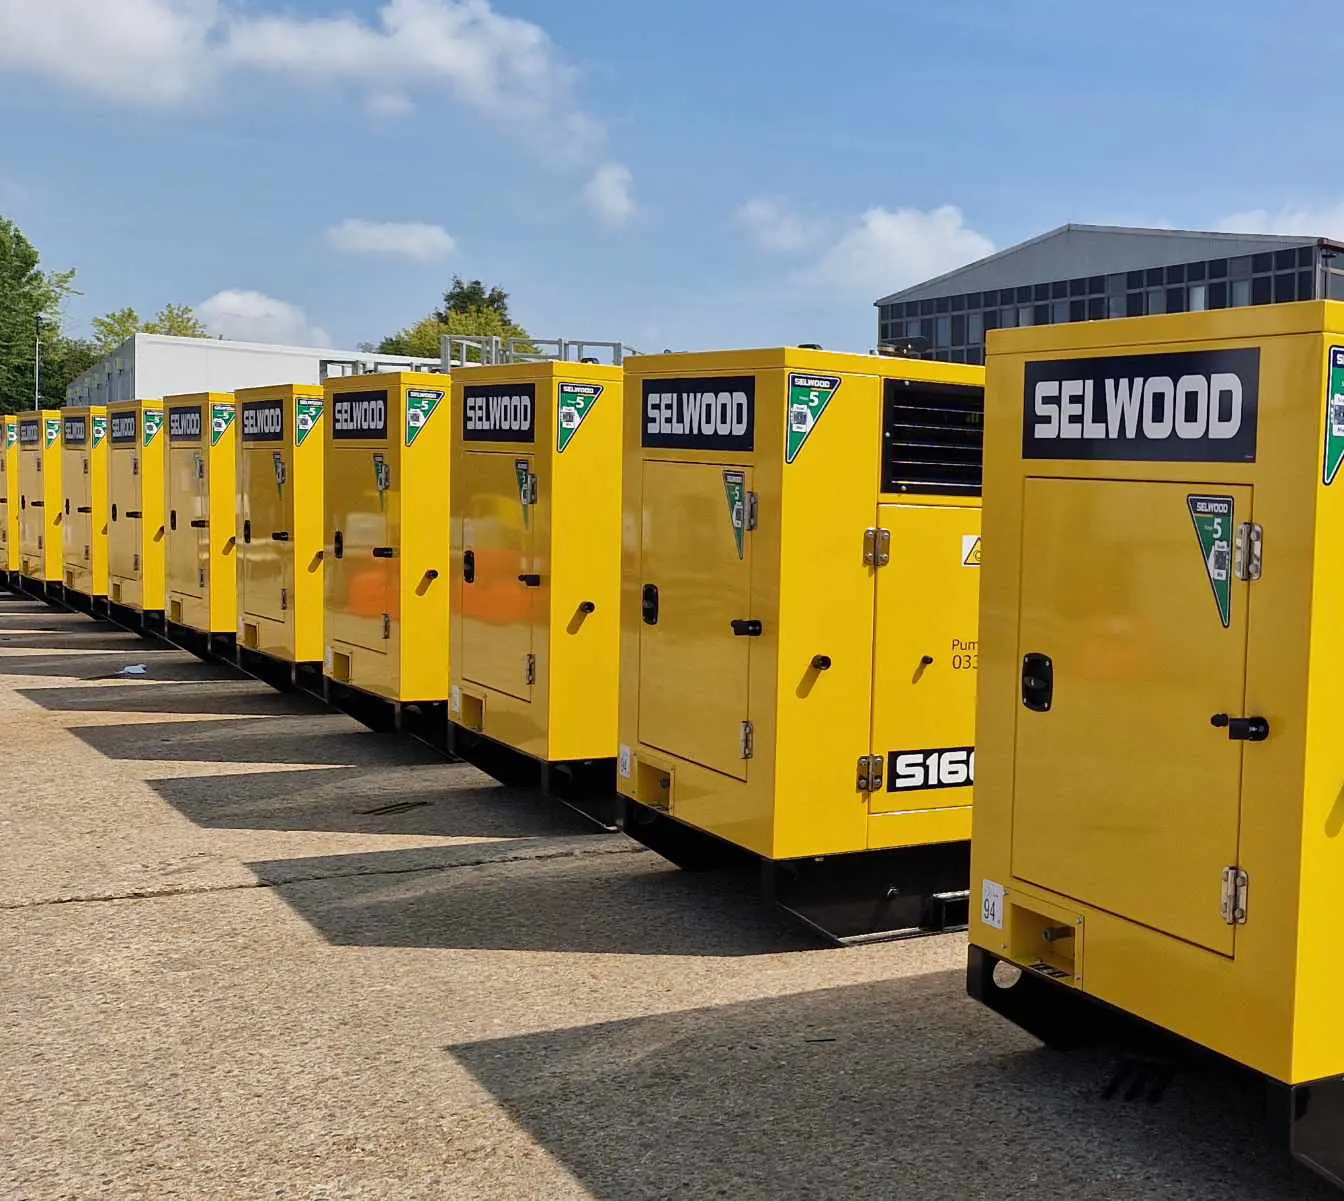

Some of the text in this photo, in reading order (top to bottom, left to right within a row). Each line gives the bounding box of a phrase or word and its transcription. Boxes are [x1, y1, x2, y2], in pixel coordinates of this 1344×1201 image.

[794, 377, 831, 388] SELWOOD
[421, 400, 429, 410] 5
[576, 396, 584, 408] 5
[809, 391, 819, 406] 5
[1034, 373, 1243, 439] SELWOOD
[170, 413, 200, 435] SELWOOD
[244, 407, 282, 434] SELWOOD
[335, 399, 385, 430] SELWOOD
[467, 395, 530, 431] SELWOOD
[647, 391, 747, 435] SELWOOD
[1196, 502, 1228, 513] SELWOOD
[1212, 518, 1222, 539] 5
[983, 898, 995, 921] 94
